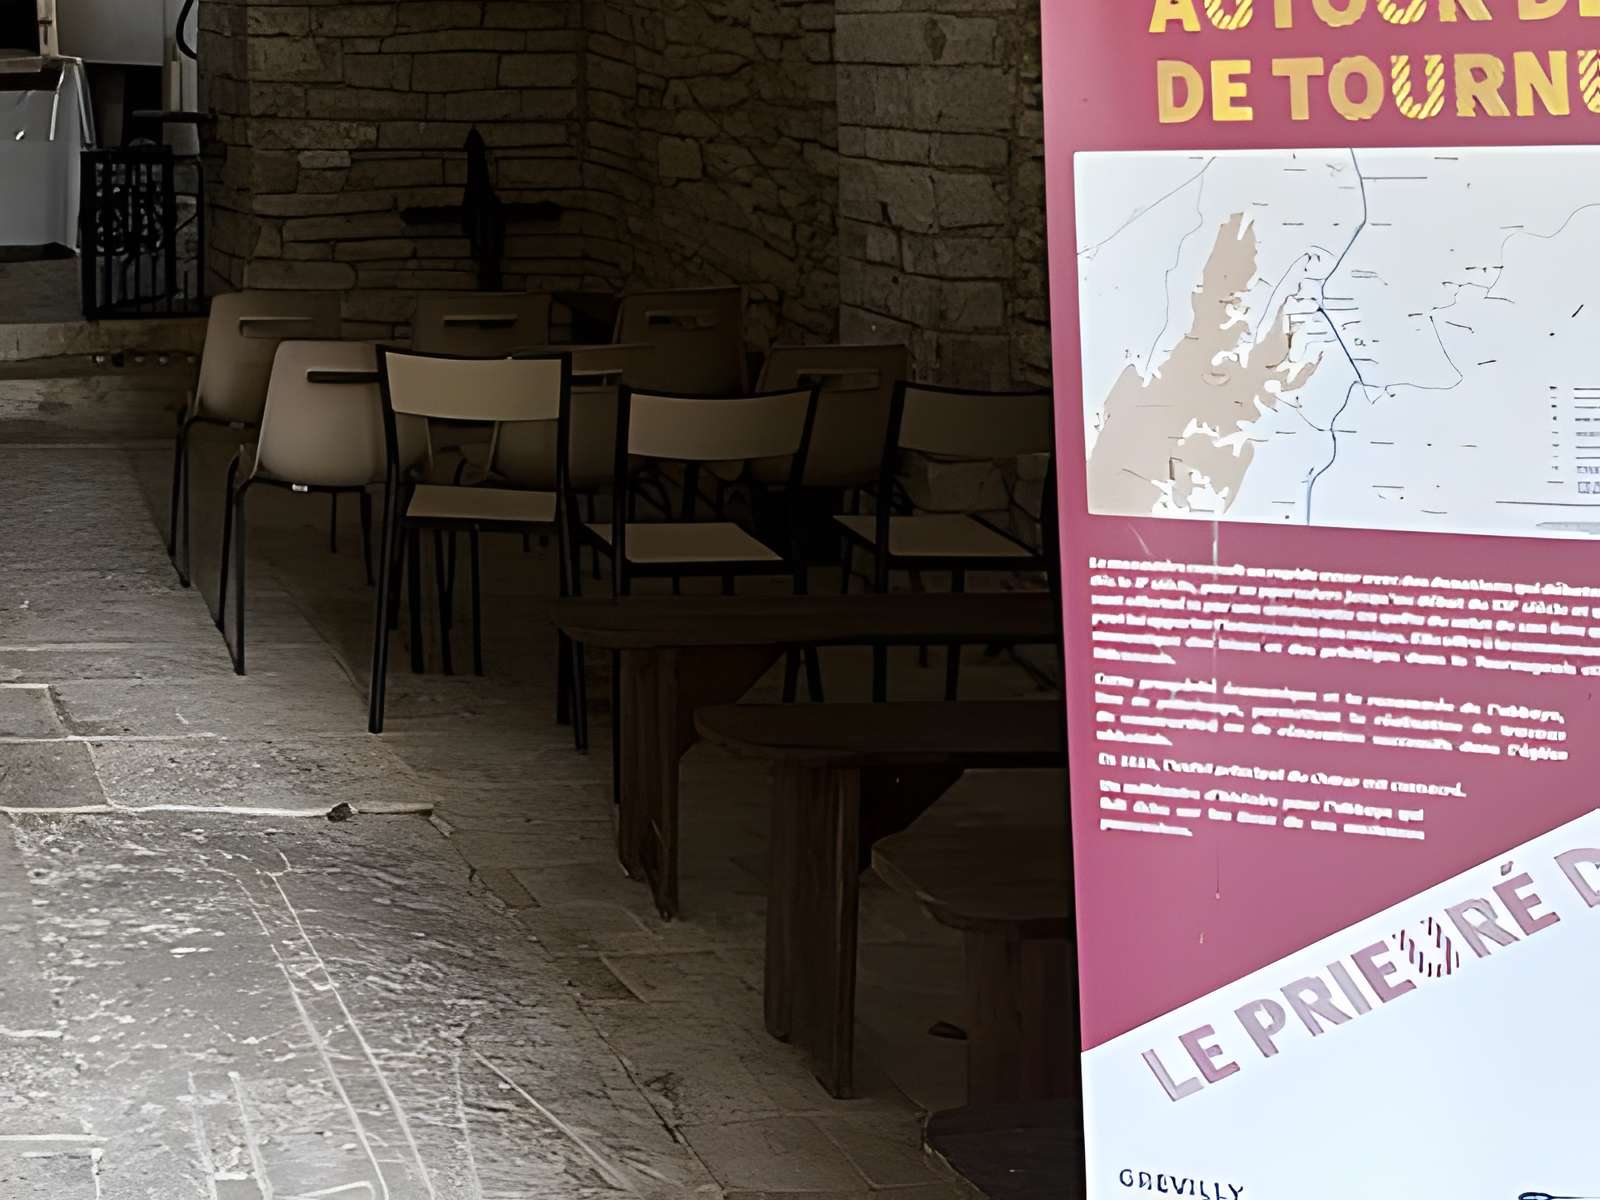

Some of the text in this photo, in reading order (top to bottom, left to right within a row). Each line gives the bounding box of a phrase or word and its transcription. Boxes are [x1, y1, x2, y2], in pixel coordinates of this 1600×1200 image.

[1157, 58, 1255, 124] DE
[1141, 1023, 1241, 1102] LE
[1234, 860, 1561, 1058] PRIEURÉ
